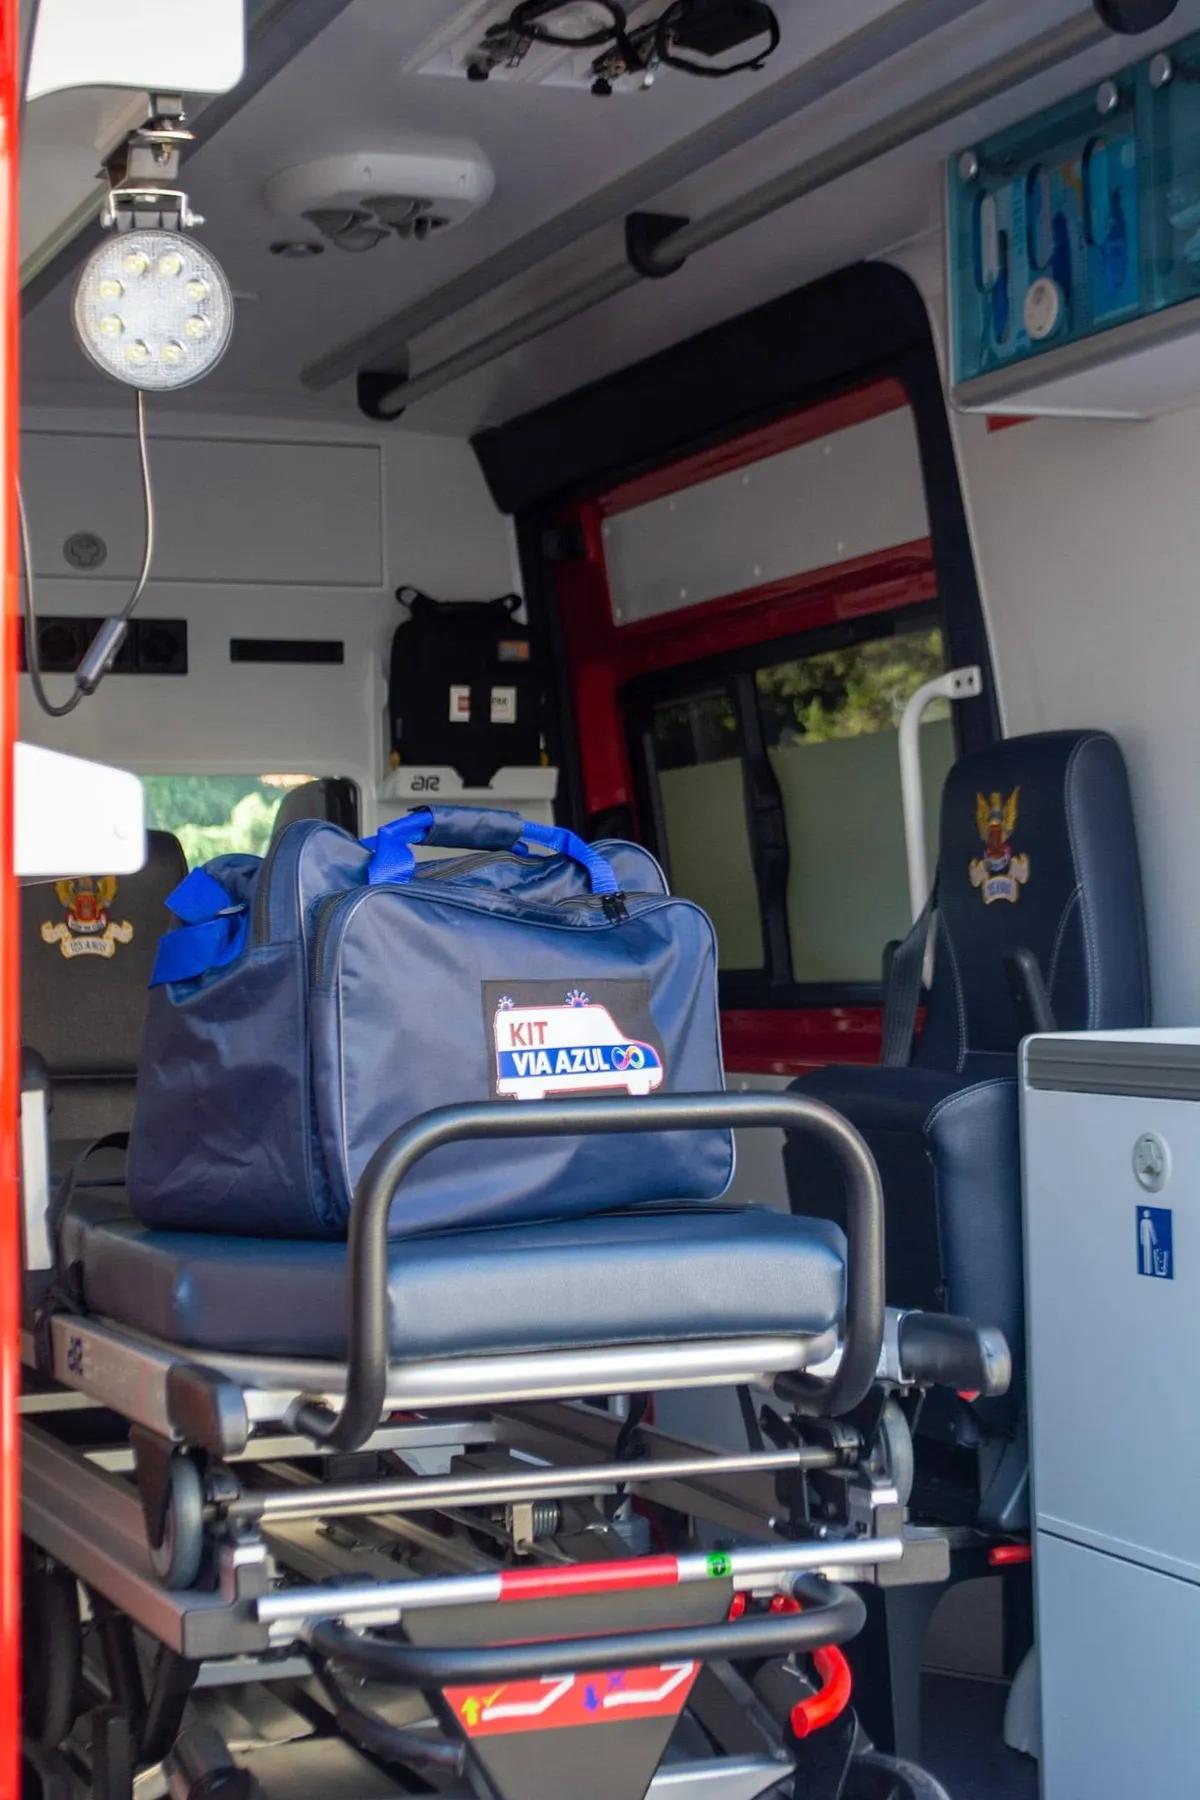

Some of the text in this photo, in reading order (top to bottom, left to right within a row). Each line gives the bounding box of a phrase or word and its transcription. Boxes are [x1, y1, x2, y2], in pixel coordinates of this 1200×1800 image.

[509, 1021, 548, 1046] KIT
[512, 1048, 610, 1076] VIA AZUL
